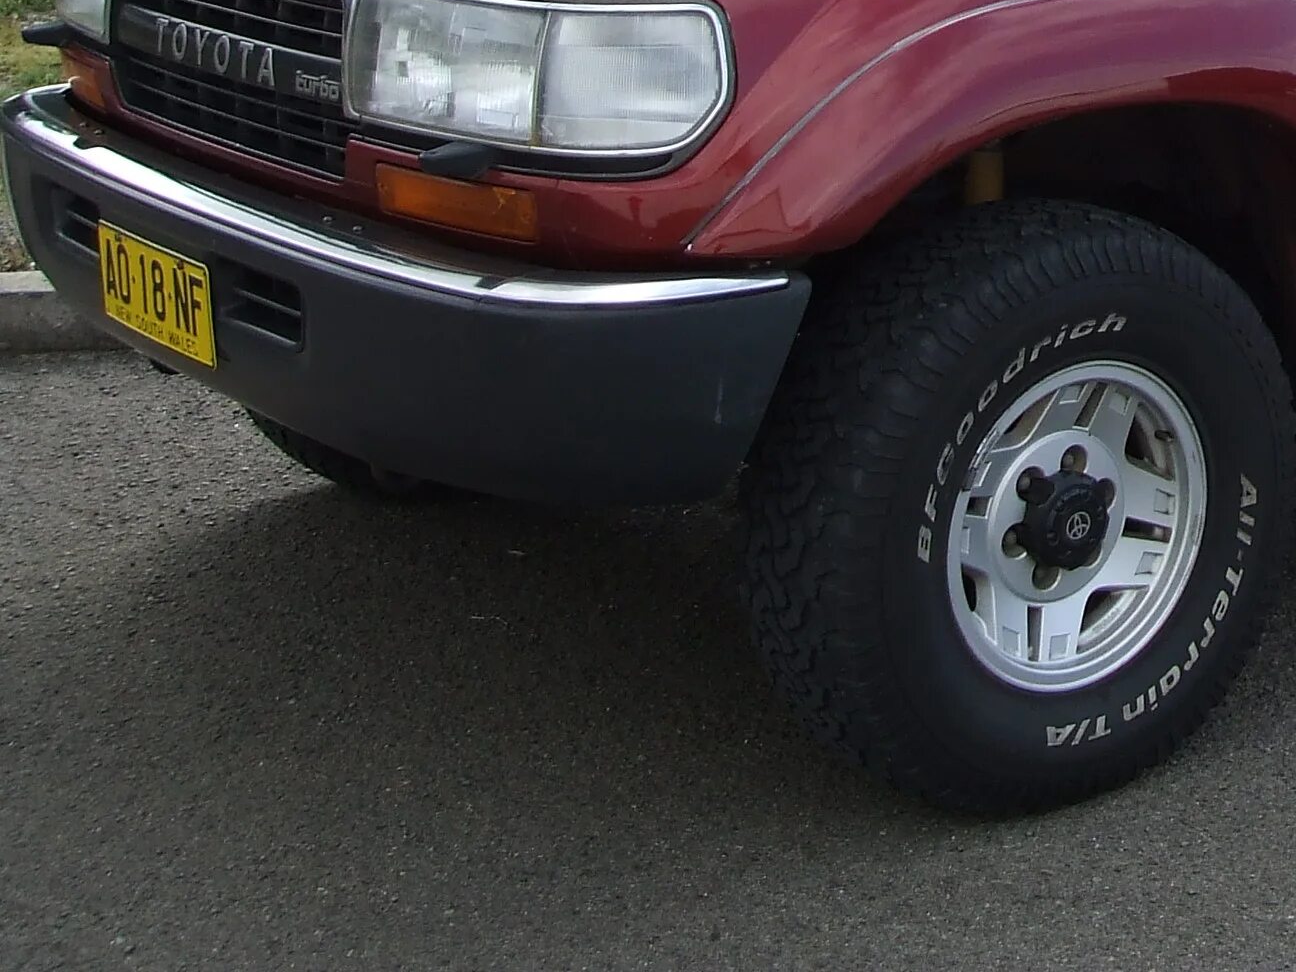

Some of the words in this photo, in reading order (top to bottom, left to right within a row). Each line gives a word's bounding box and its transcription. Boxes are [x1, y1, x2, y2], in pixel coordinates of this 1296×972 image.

[156, 17, 275, 87] TOYOTA
[295, 69, 341, 102] turbo
[916, 312, 1128, 564] BFGoodrich
[1121, 473, 1260, 722] All-Terrain
[1045, 714, 1112, 748] T/A
